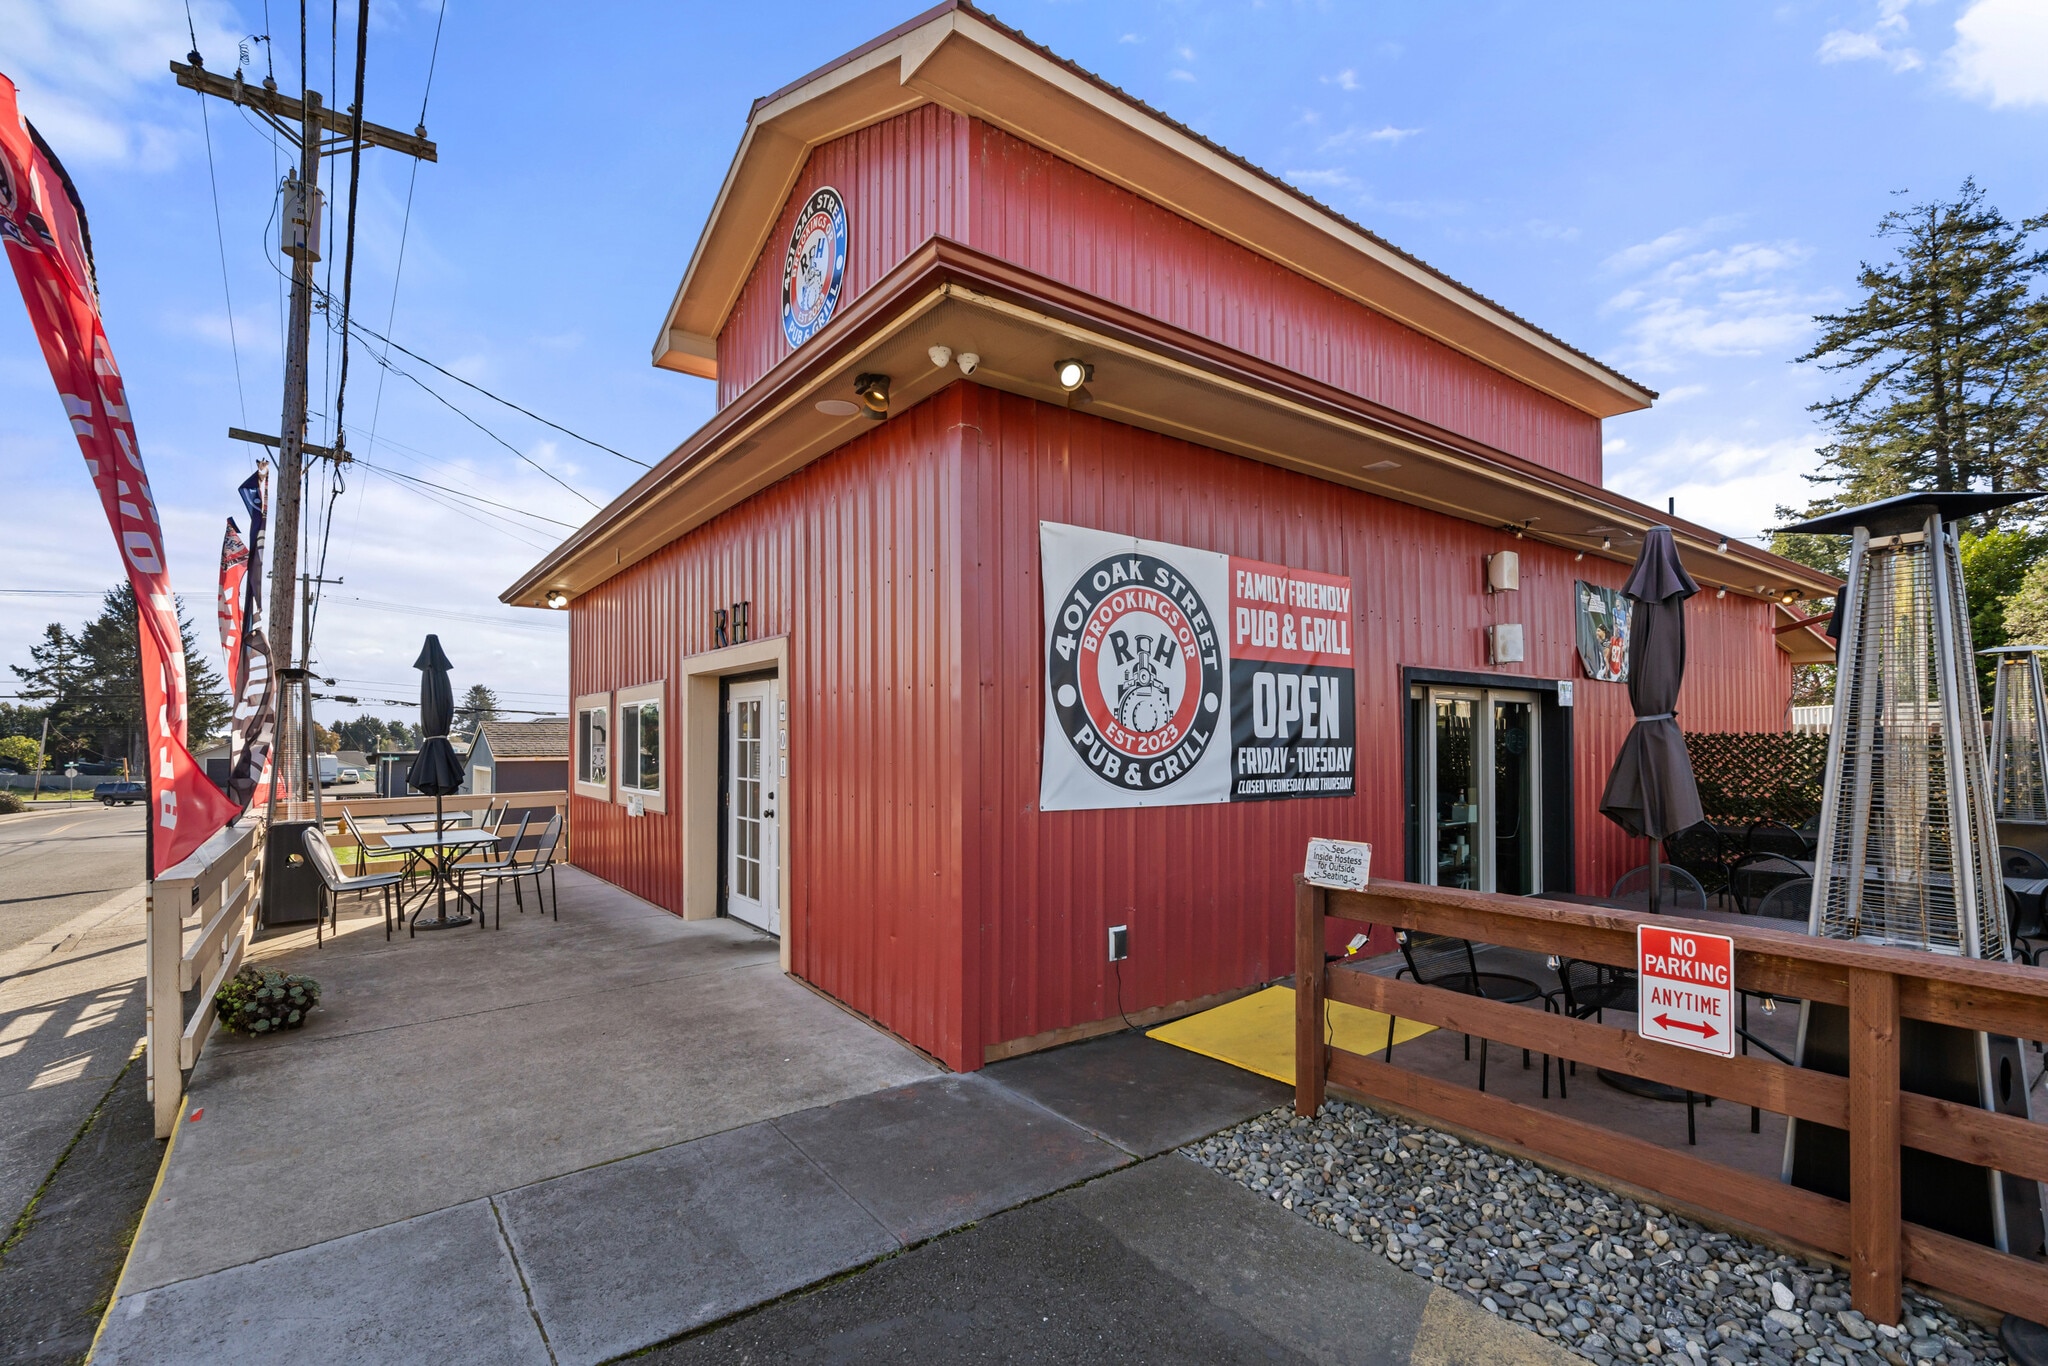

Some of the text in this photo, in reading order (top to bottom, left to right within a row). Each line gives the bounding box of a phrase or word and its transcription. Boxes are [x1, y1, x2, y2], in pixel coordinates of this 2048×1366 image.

[795, 201, 814, 240] OAK
[817, 193, 844, 239] STREET
[791, 215, 827, 278] BROOKINGS
[788, 321, 803, 345] PUB
[811, 283, 839, 335] GRILL
[798, 311, 808, 323] EST
[1236, 569, 1350, 614] FAMILY FRIENDLY
[1055, 559, 1219, 671] 401 OAK STREET
[1083, 591, 1196, 660] BROOKINGS OR
[1236, 606, 1351, 655] PUB & GRILL
[1252, 671, 1340, 739] OPEN
[1105, 721, 1179, 753] EST 2023
[1072, 723, 1210, 787] PUB & GRILL
[1238, 746, 1289, 775] FRIDAY
[1296, 746, 1353, 773] TUESDAY
[1237, 776, 1353, 794] CLOSED WEDNESDAY AND THURSDAY
[1313, 851, 1362, 866] Inside Hostess
[1331, 844, 1345, 854] See
[1317, 861, 1355, 873] for Outside
[1322, 870, 1349, 884] Seating
[1670, 936, 1697, 958] NO
[1644, 953, 1728, 985] PARKING
[1651, 986, 1722, 1017] ANYTIME
